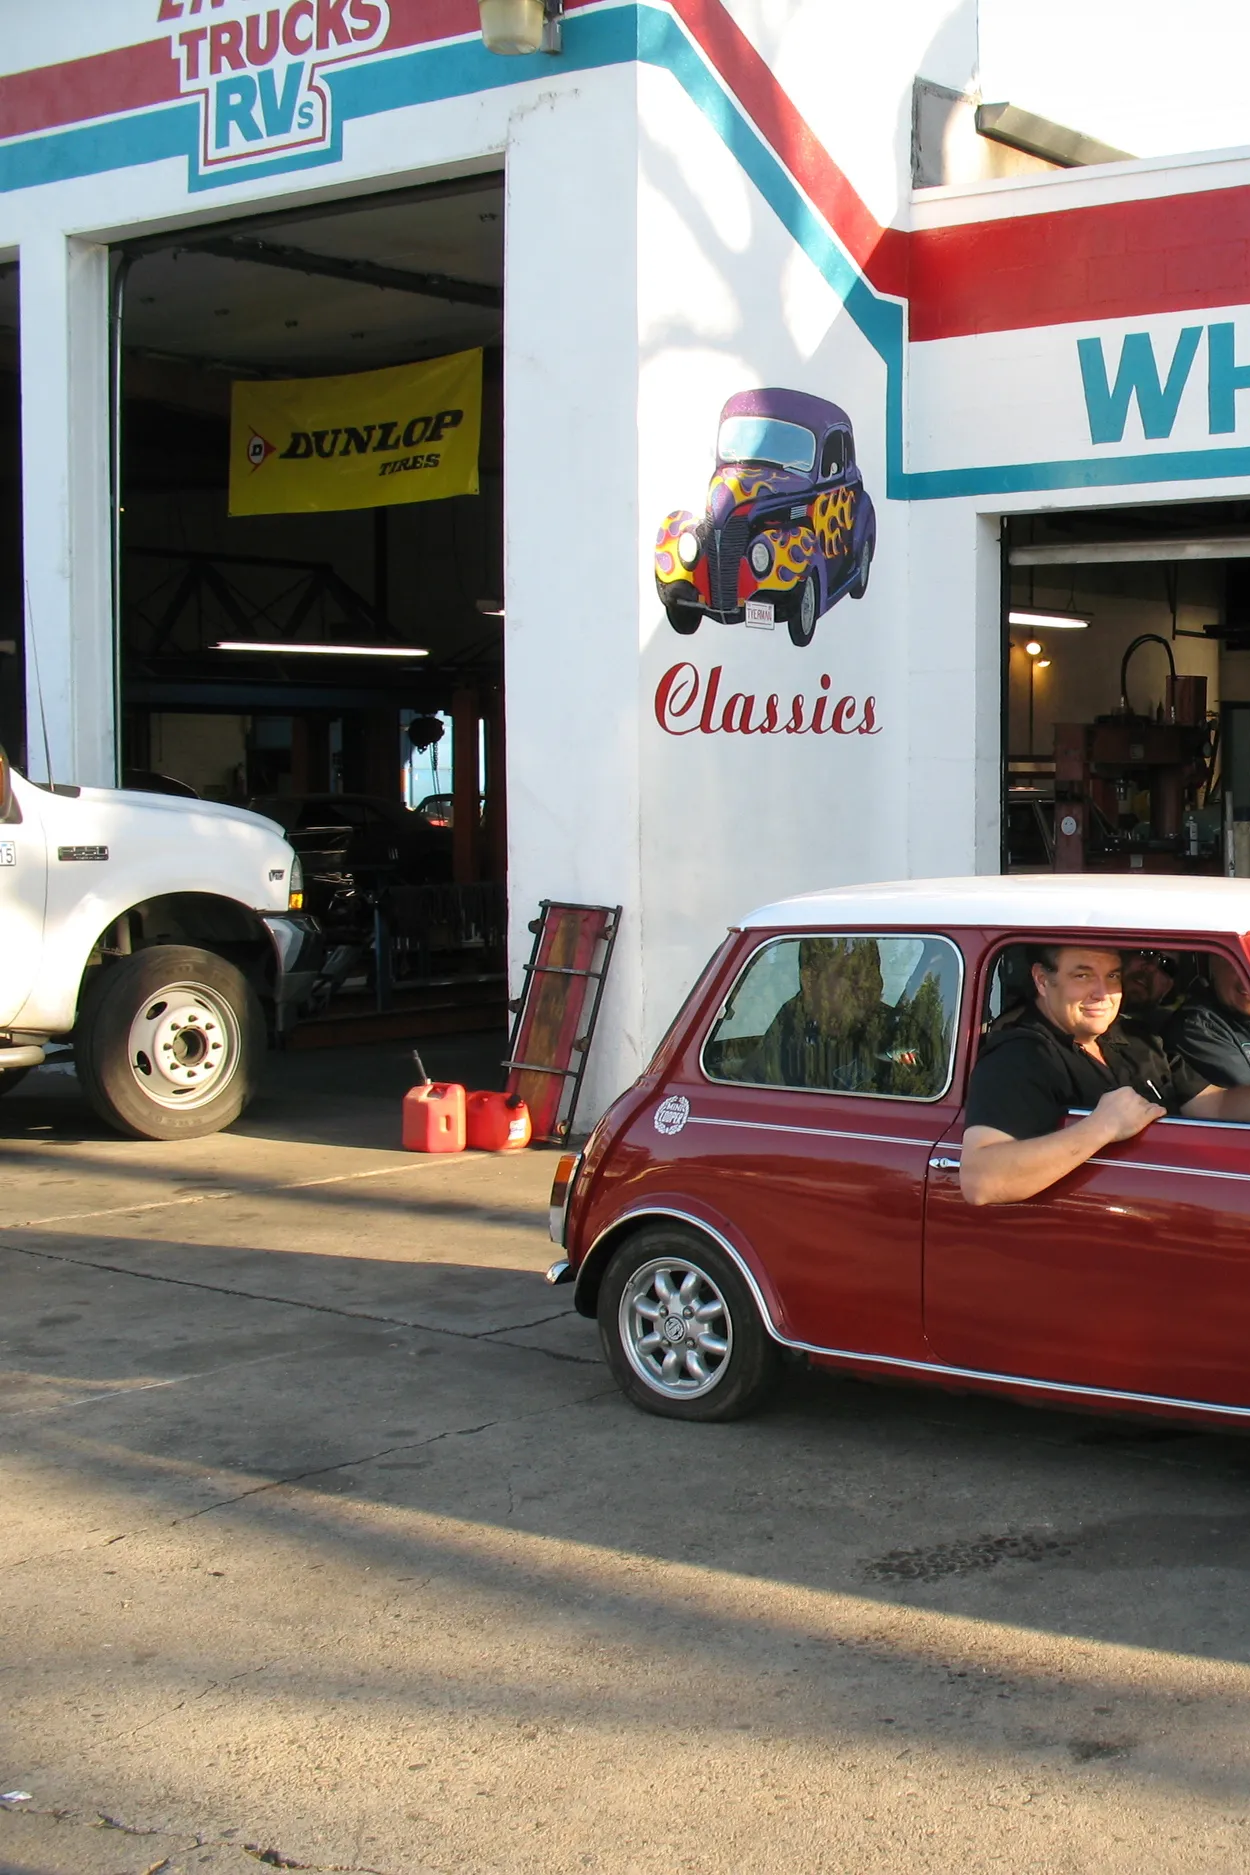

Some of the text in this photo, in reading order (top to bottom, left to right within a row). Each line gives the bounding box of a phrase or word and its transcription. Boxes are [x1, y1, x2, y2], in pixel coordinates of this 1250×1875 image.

[178, 0, 383, 81] TRUCKS
[279, 409, 464, 460] DUNLOP
[378, 453, 441, 477] TIRES
[654, 661, 883, 736] Classics
